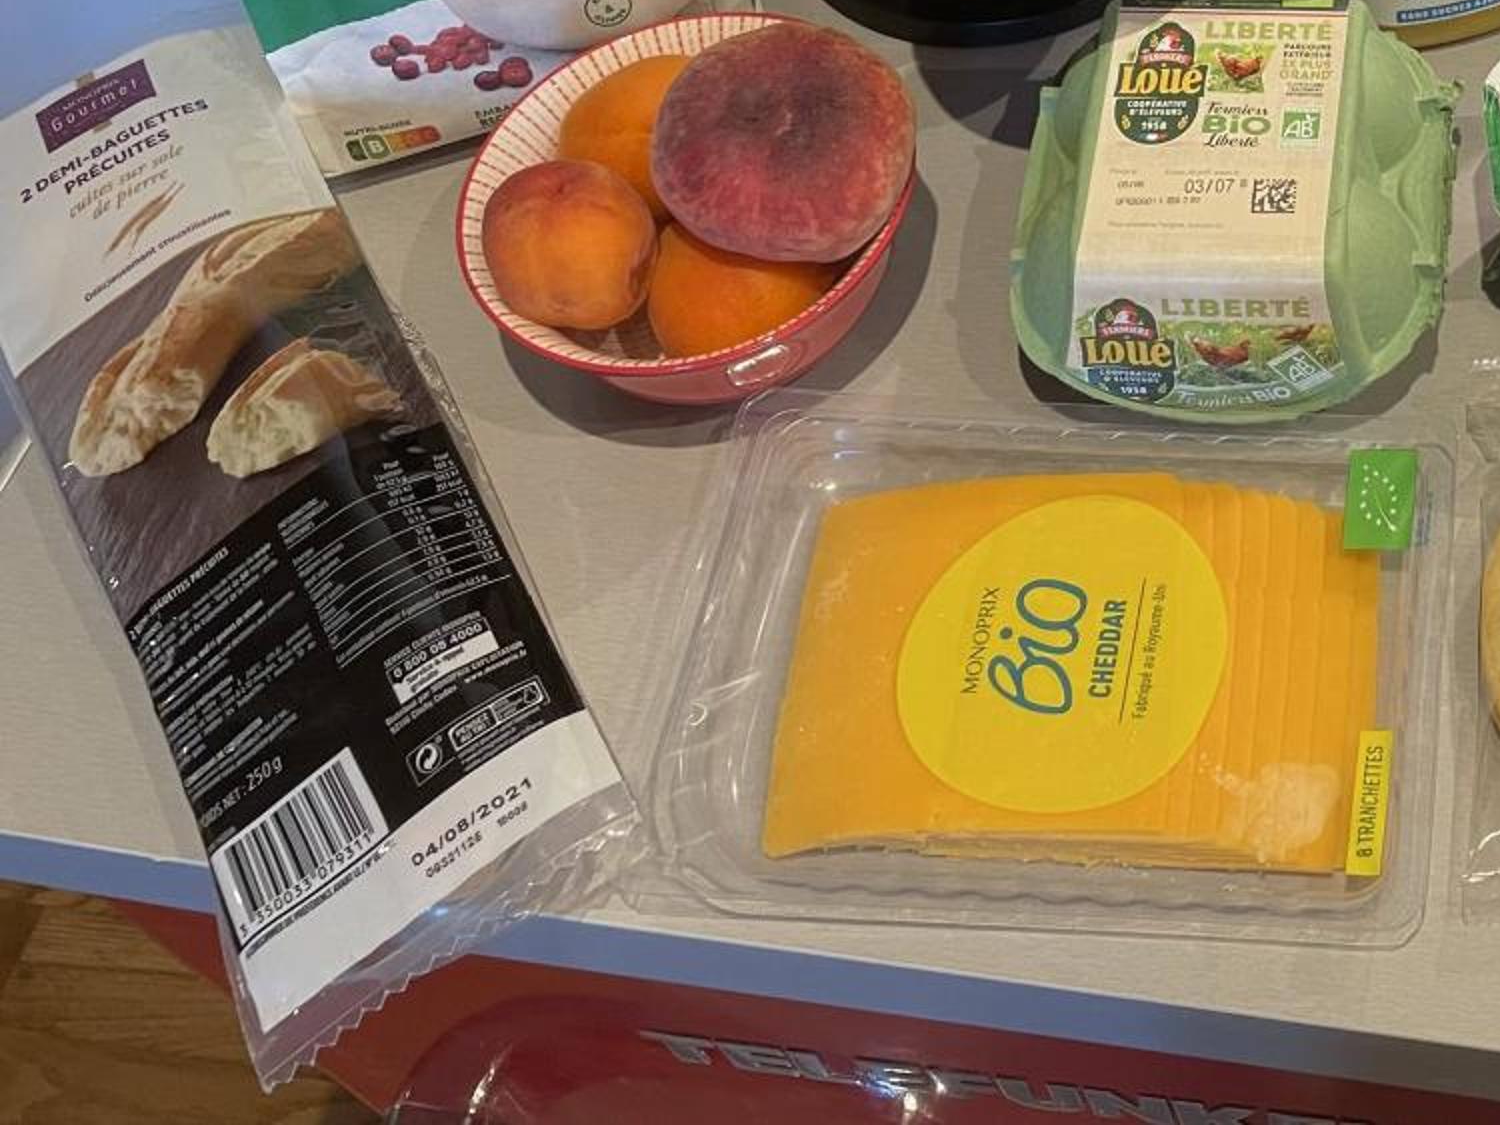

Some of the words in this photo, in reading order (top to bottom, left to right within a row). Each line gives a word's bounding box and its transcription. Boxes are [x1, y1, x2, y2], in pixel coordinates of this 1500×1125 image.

[1205, 19, 1333, 41] LIBERTÉ
[1119, 61, 1204, 95] Loué
[50, 78, 138, 132] Gourmet
[20, 188, 33, 204] 2
[35, 98, 210, 194] DEMI-BAGUETTES
[64, 128, 172, 195] PRÉCUITES
[369, 140, 386, 154] B
[116, 168, 170, 213] pierre
[1183, 178, 1236, 195] 03/07
[1161, 296, 1311, 318] LIBERTÉ
[1085, 336, 1172, 368] Loué
[392, 668, 403, 679] 0
[403, 650, 428, 671] 800
[450, 622, 483, 644] 4000
[960, 585, 1001, 695] MONOPRIX
[1087, 597, 1129, 699] CHEDDAR
[1357, 744, 1384, 842] TRANCHETTES
[411, 777, 533, 867] 04/08/2021
[316, 829, 374, 880] 079311
[1355, 842, 1373, 859] 8
[640, 1029, 1375, 1125] TELEFUNK
